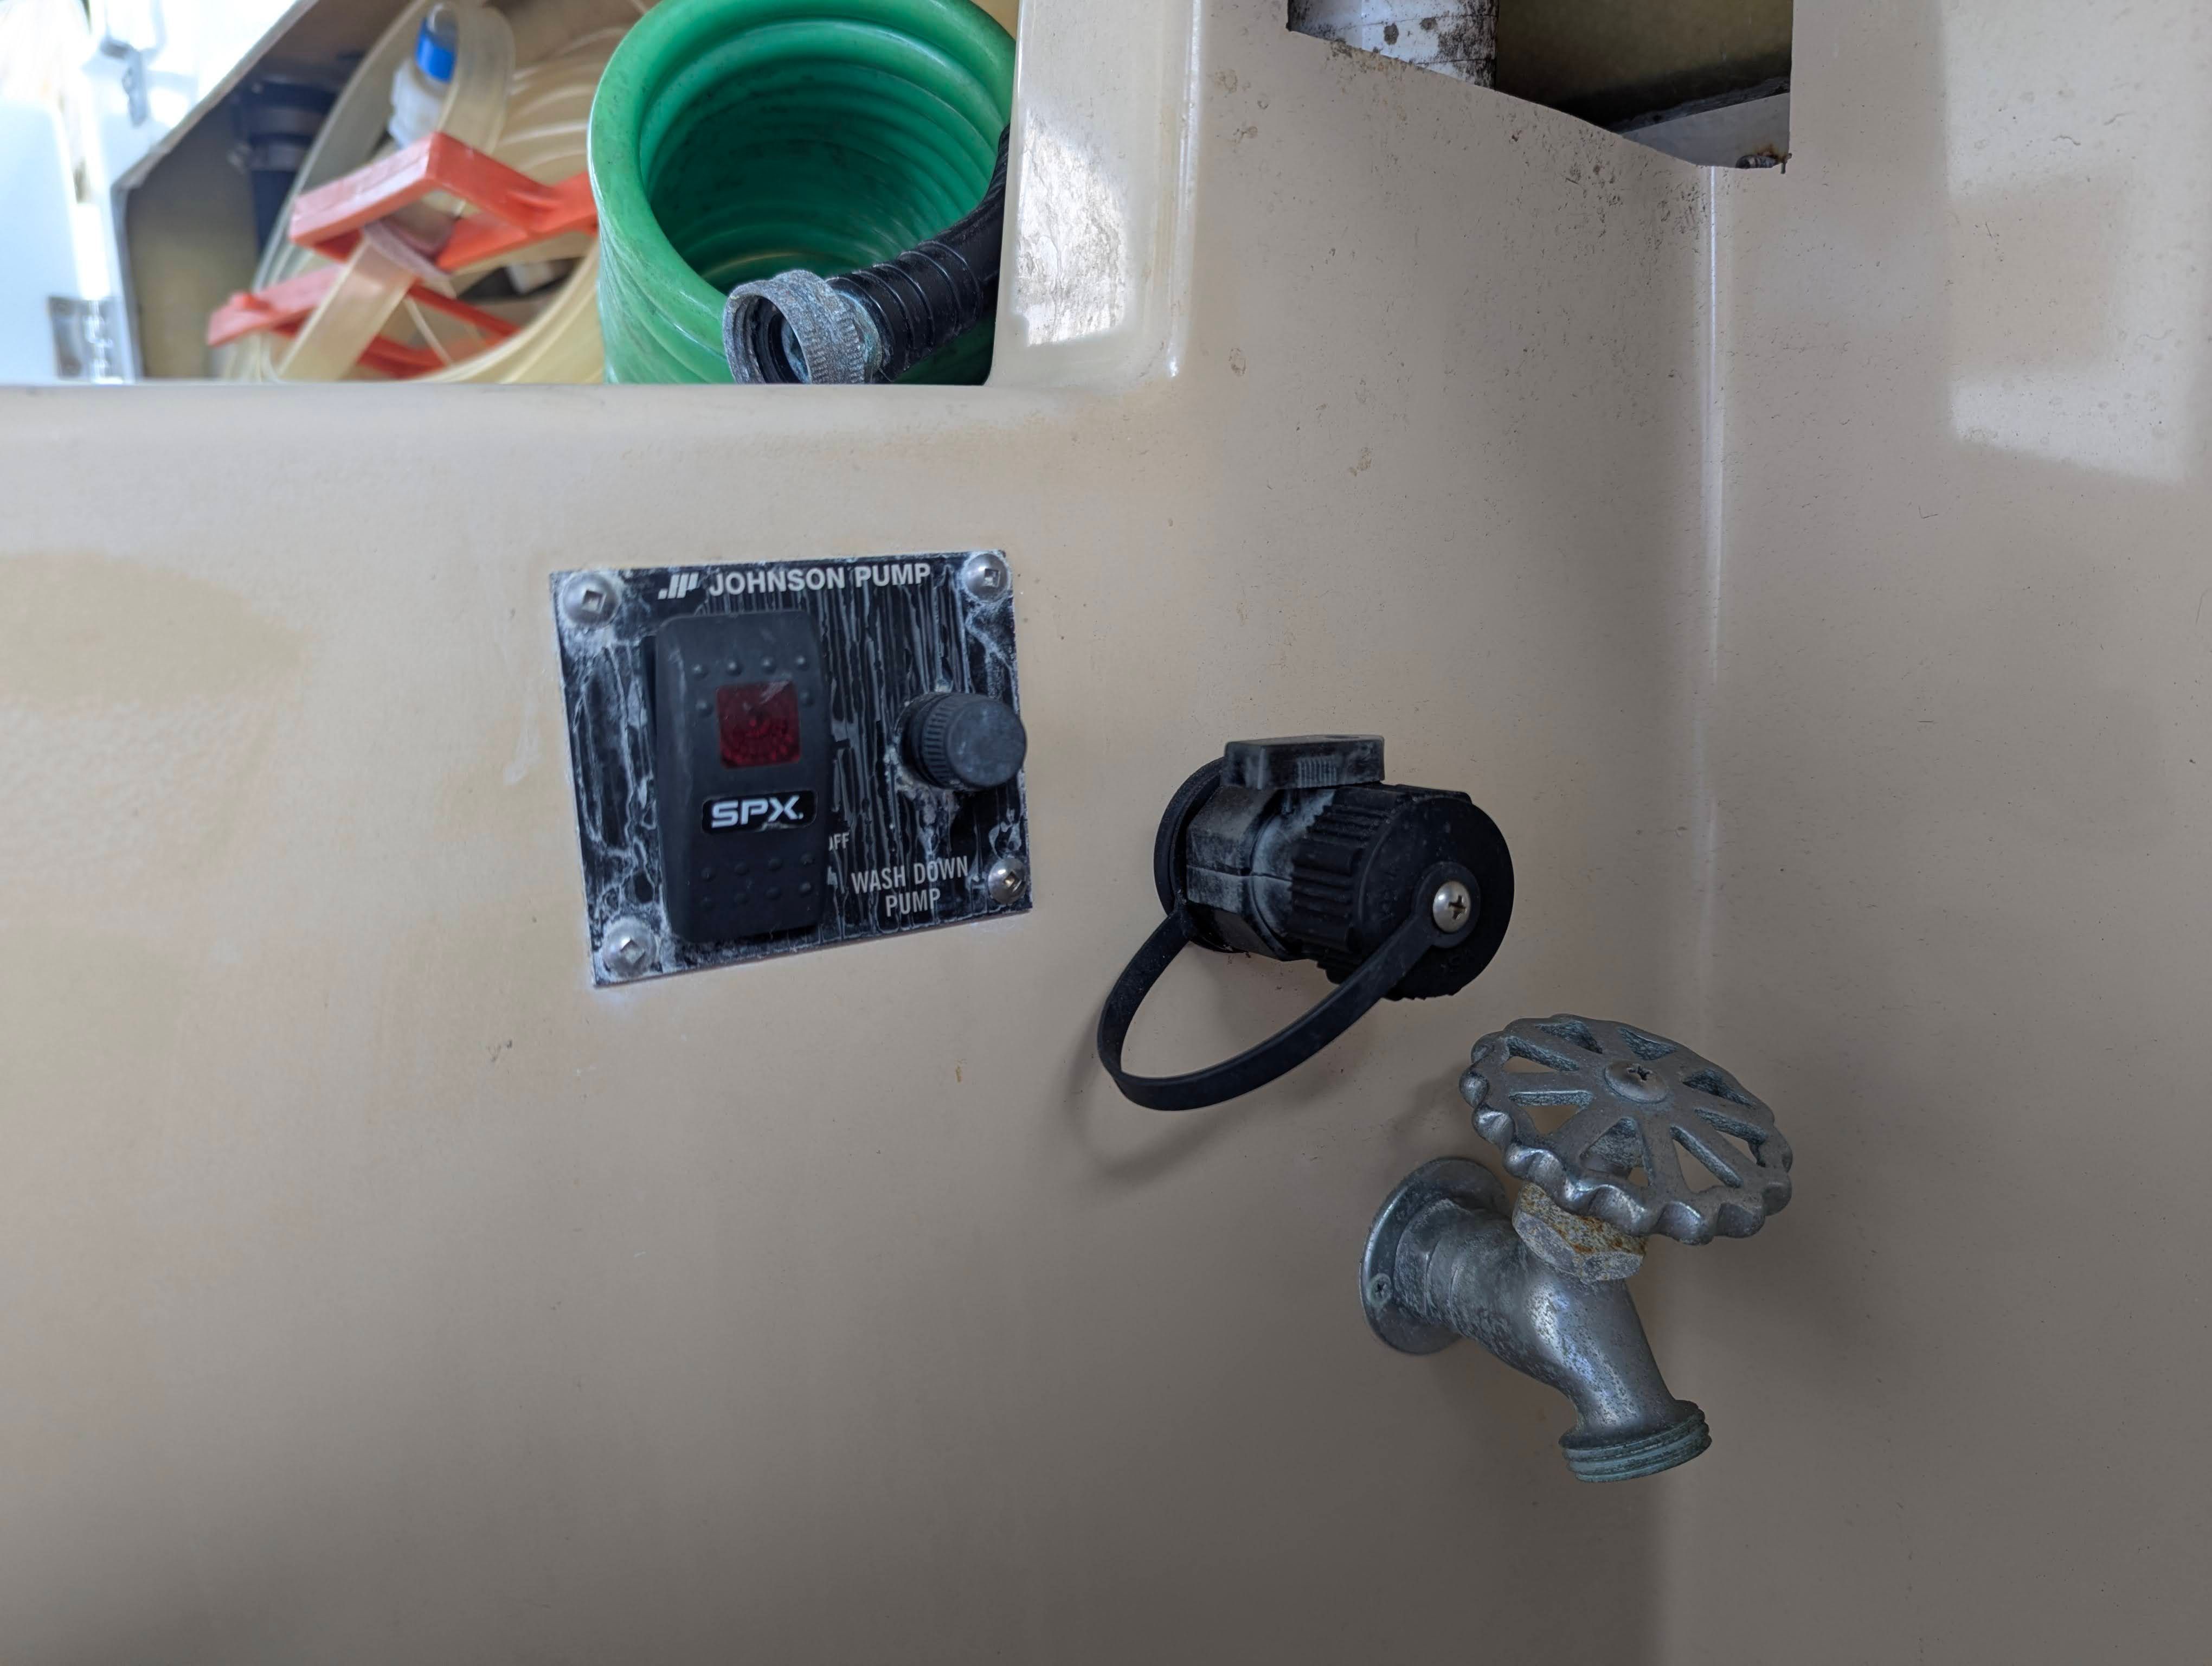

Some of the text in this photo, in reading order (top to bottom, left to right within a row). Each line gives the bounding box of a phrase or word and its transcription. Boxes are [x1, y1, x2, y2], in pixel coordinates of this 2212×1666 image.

[709, 563, 931, 597] JOHNSON PUMP
[851, 855, 968, 894] WASH DOWN
[885, 888, 941, 918] PUMP
